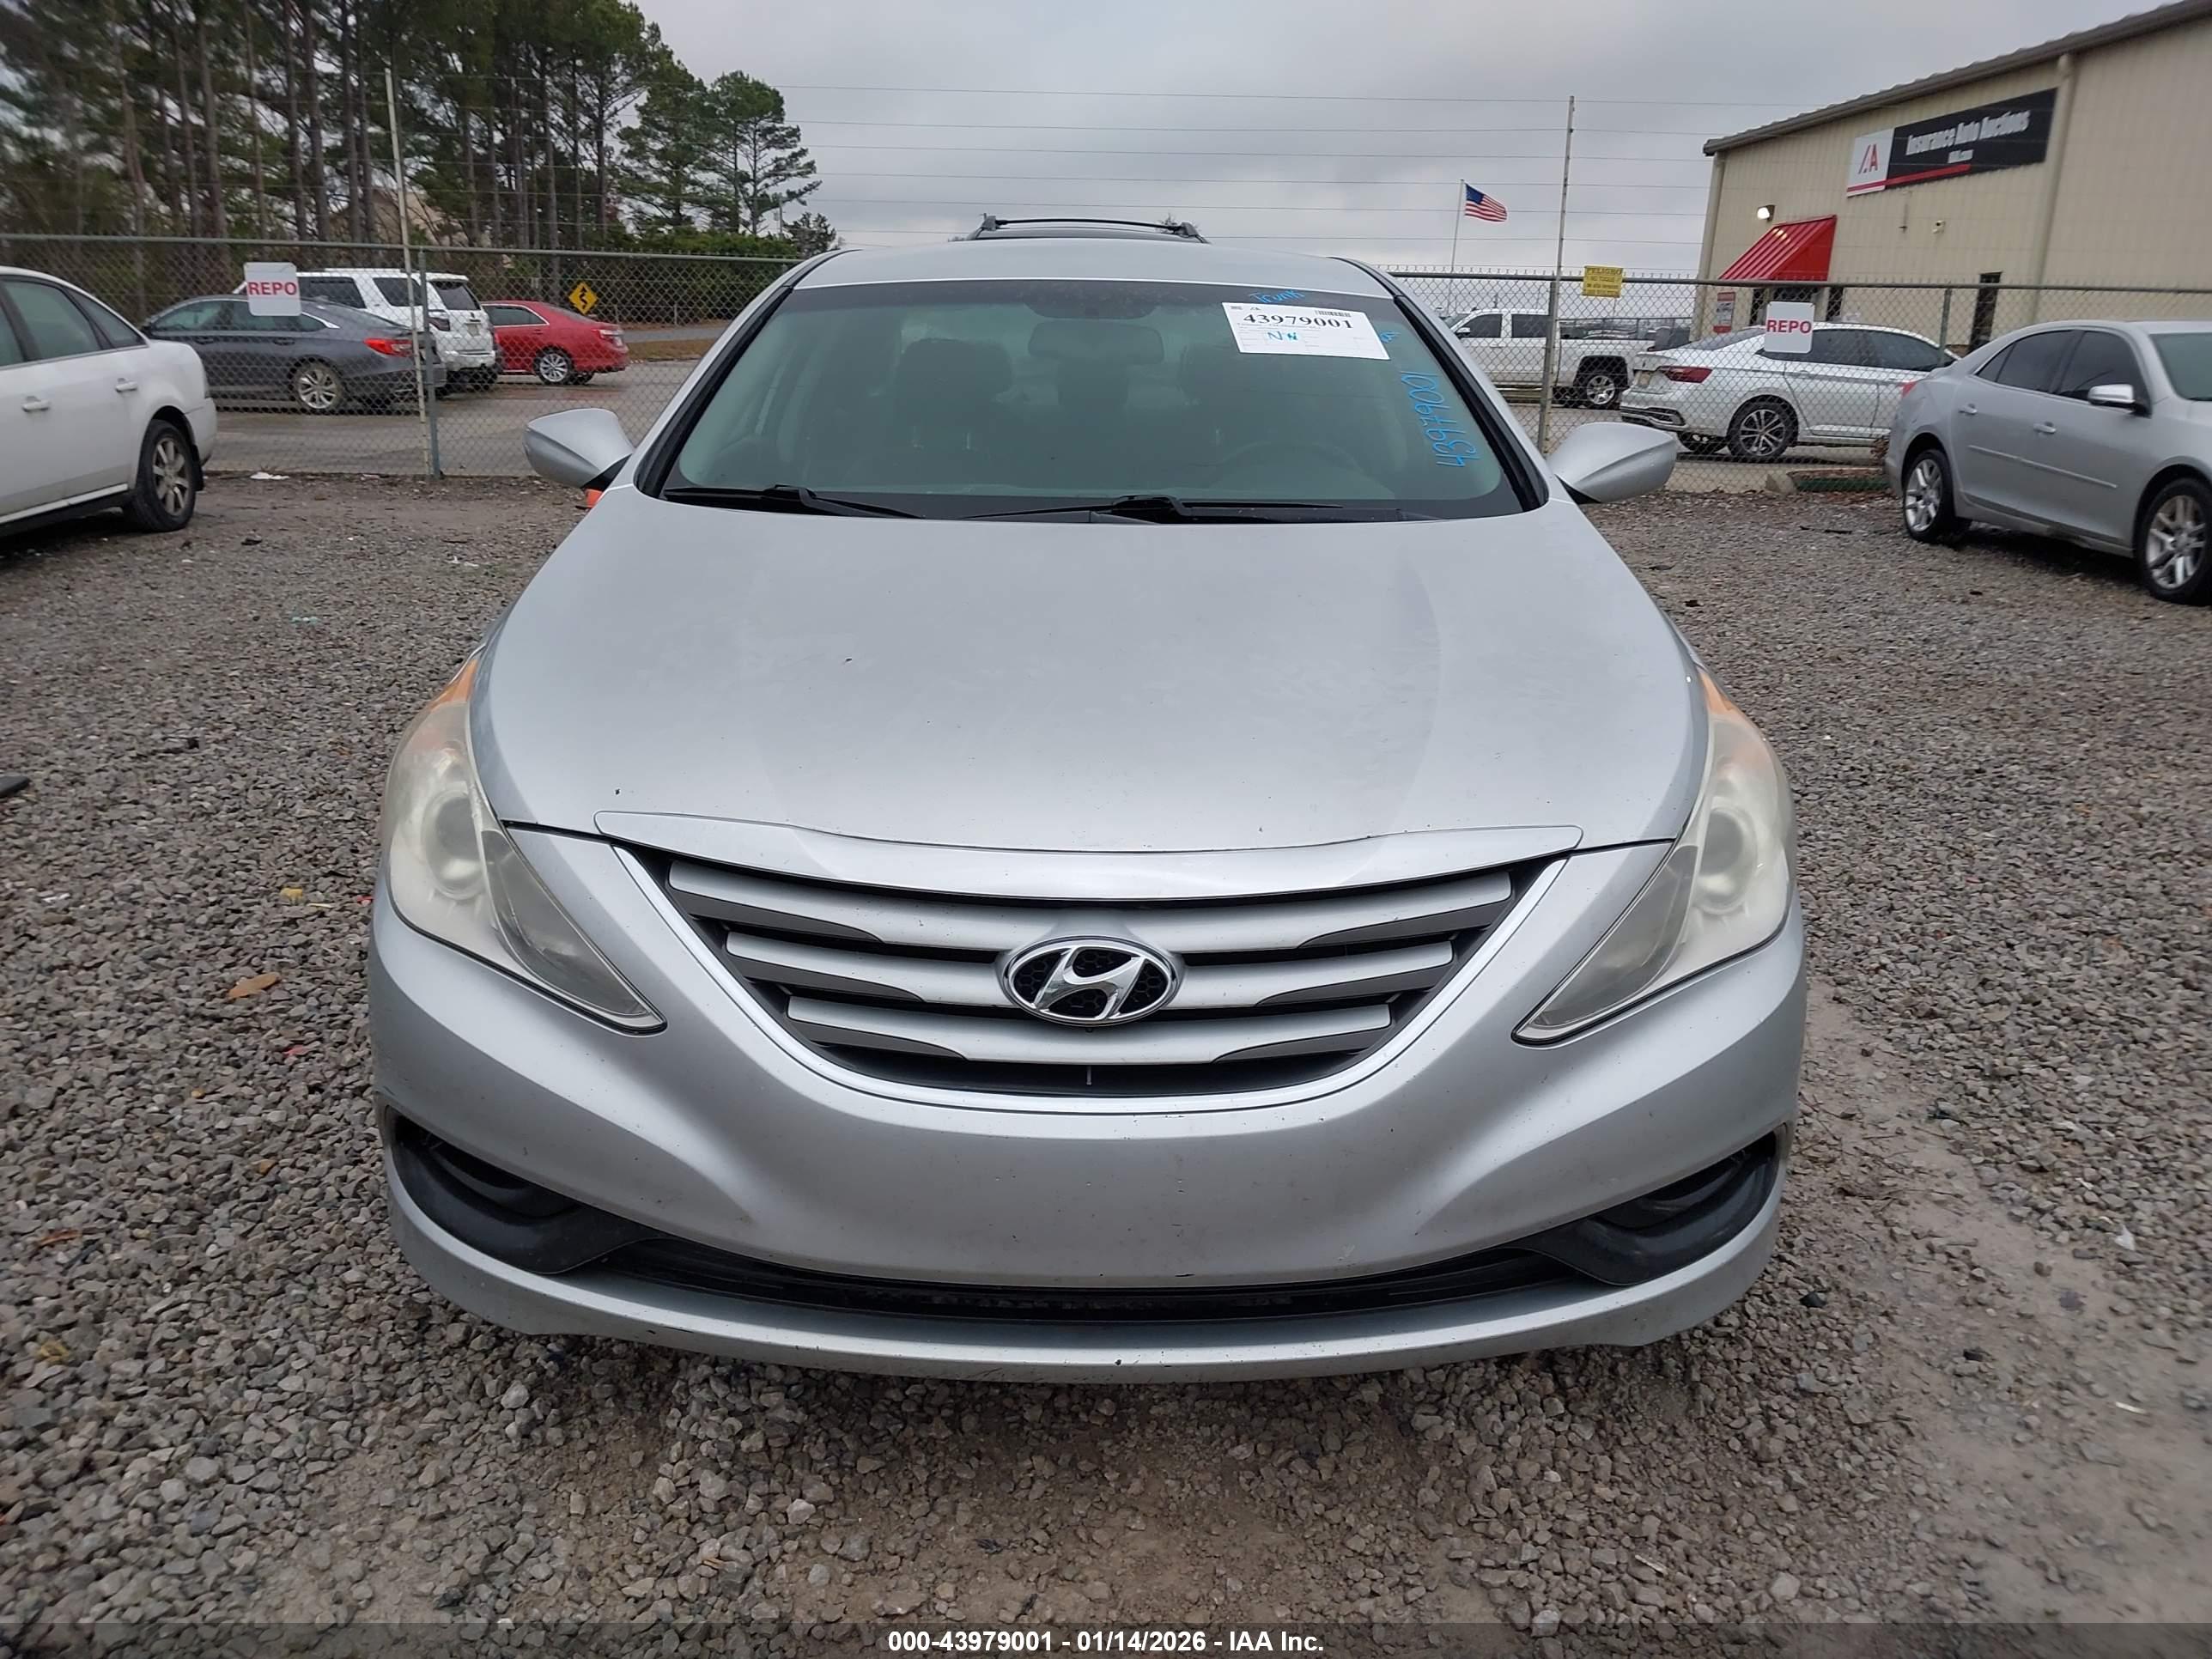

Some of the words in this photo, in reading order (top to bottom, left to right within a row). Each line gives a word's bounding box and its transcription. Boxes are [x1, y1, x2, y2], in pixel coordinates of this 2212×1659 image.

[1905, 128, 1955, 155] Insurance
[1954, 121, 1981, 145] Auto
[1978, 110, 2032, 140] Auctions
[248, 282, 297, 295] REPO
[1243, 313, 1353, 329] 43979001
[1766, 319, 1812, 333] REPO
[1401, 371, 1480, 466] 43979001
